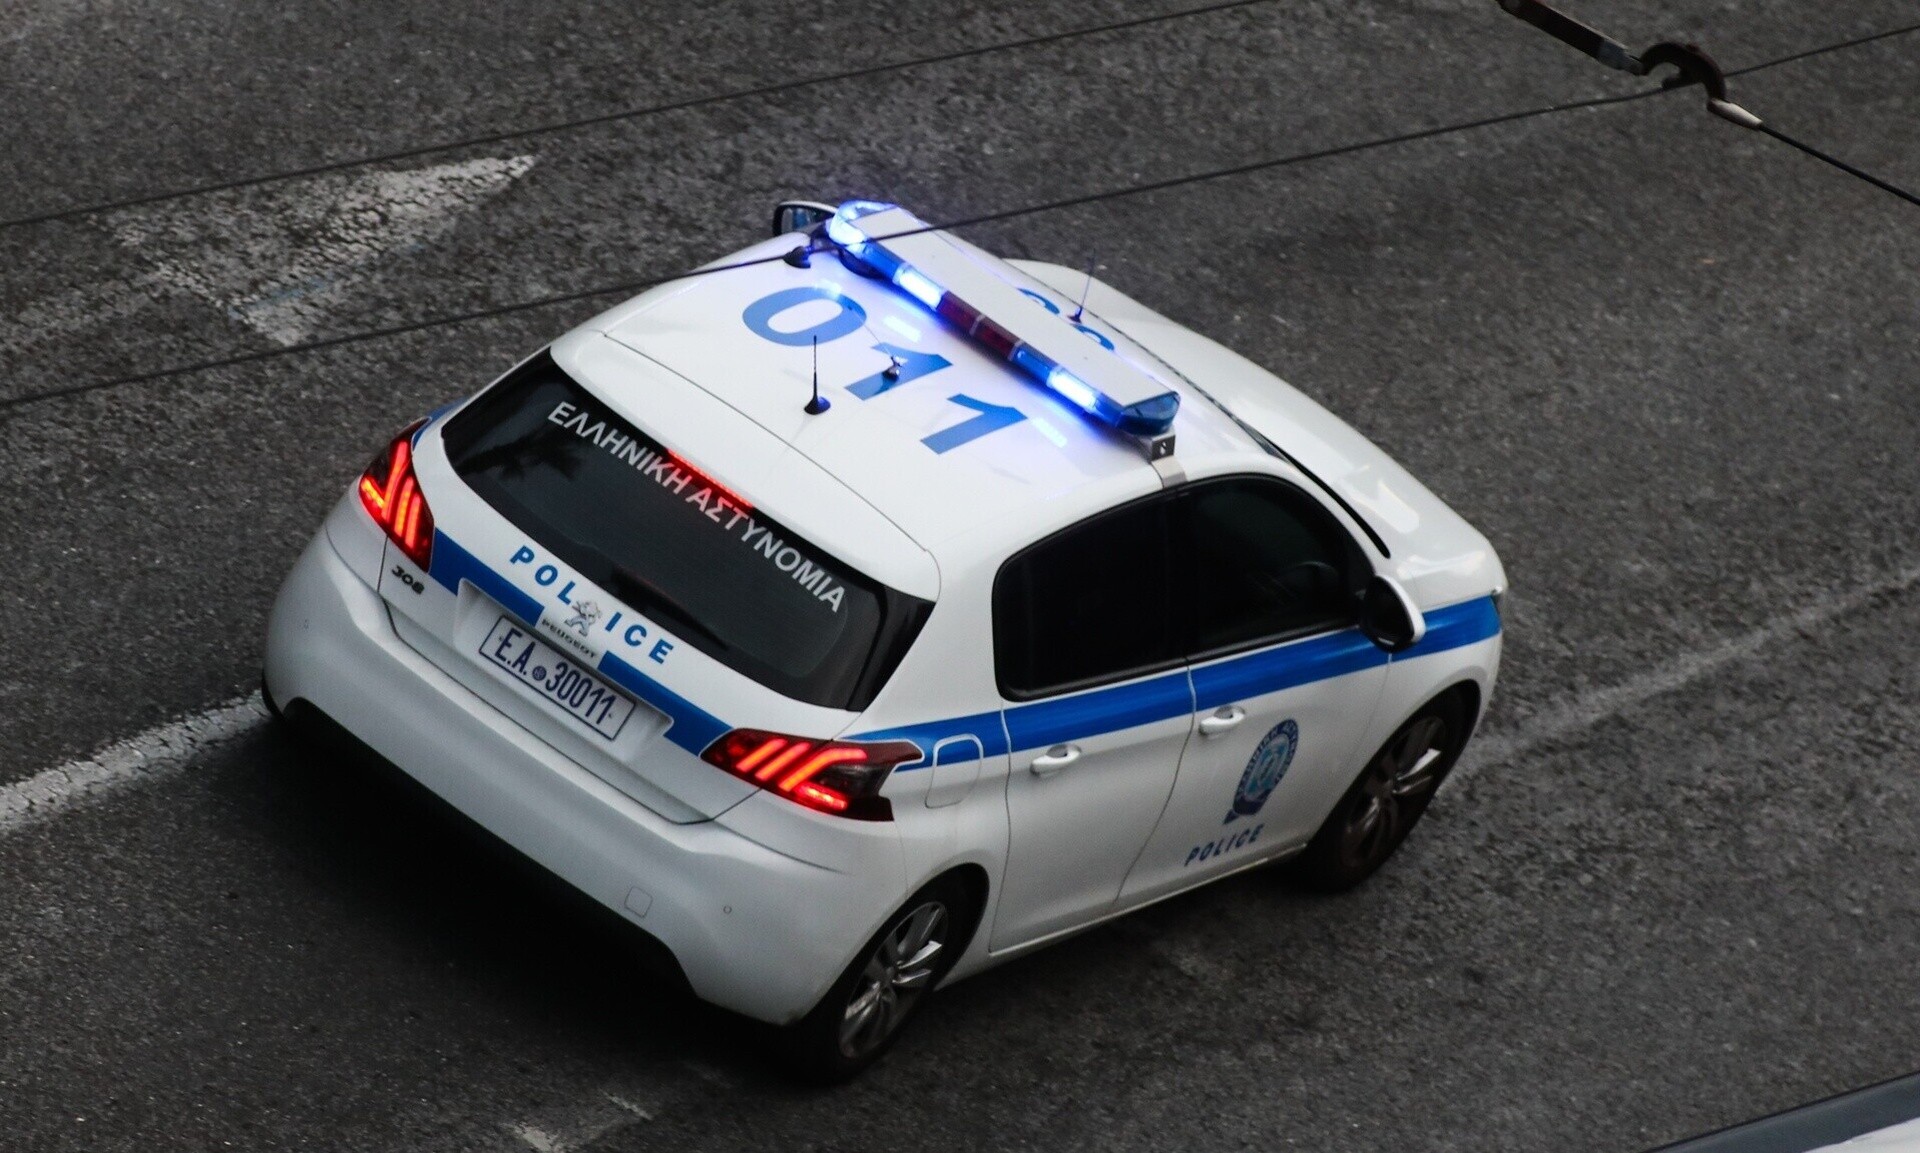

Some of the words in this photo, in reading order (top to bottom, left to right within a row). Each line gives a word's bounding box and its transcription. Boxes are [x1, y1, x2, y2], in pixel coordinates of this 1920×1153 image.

[742, 286, 1029, 455] 011
[547, 401, 692, 495] ΕΛΛΗΝΙΚΗ
[685, 487, 846, 613] ΑΣΤΥΝΟΜΙΑ
[541, 618, 597, 659] PEUGEOT
[1184, 823, 1265, 867] POLICE
